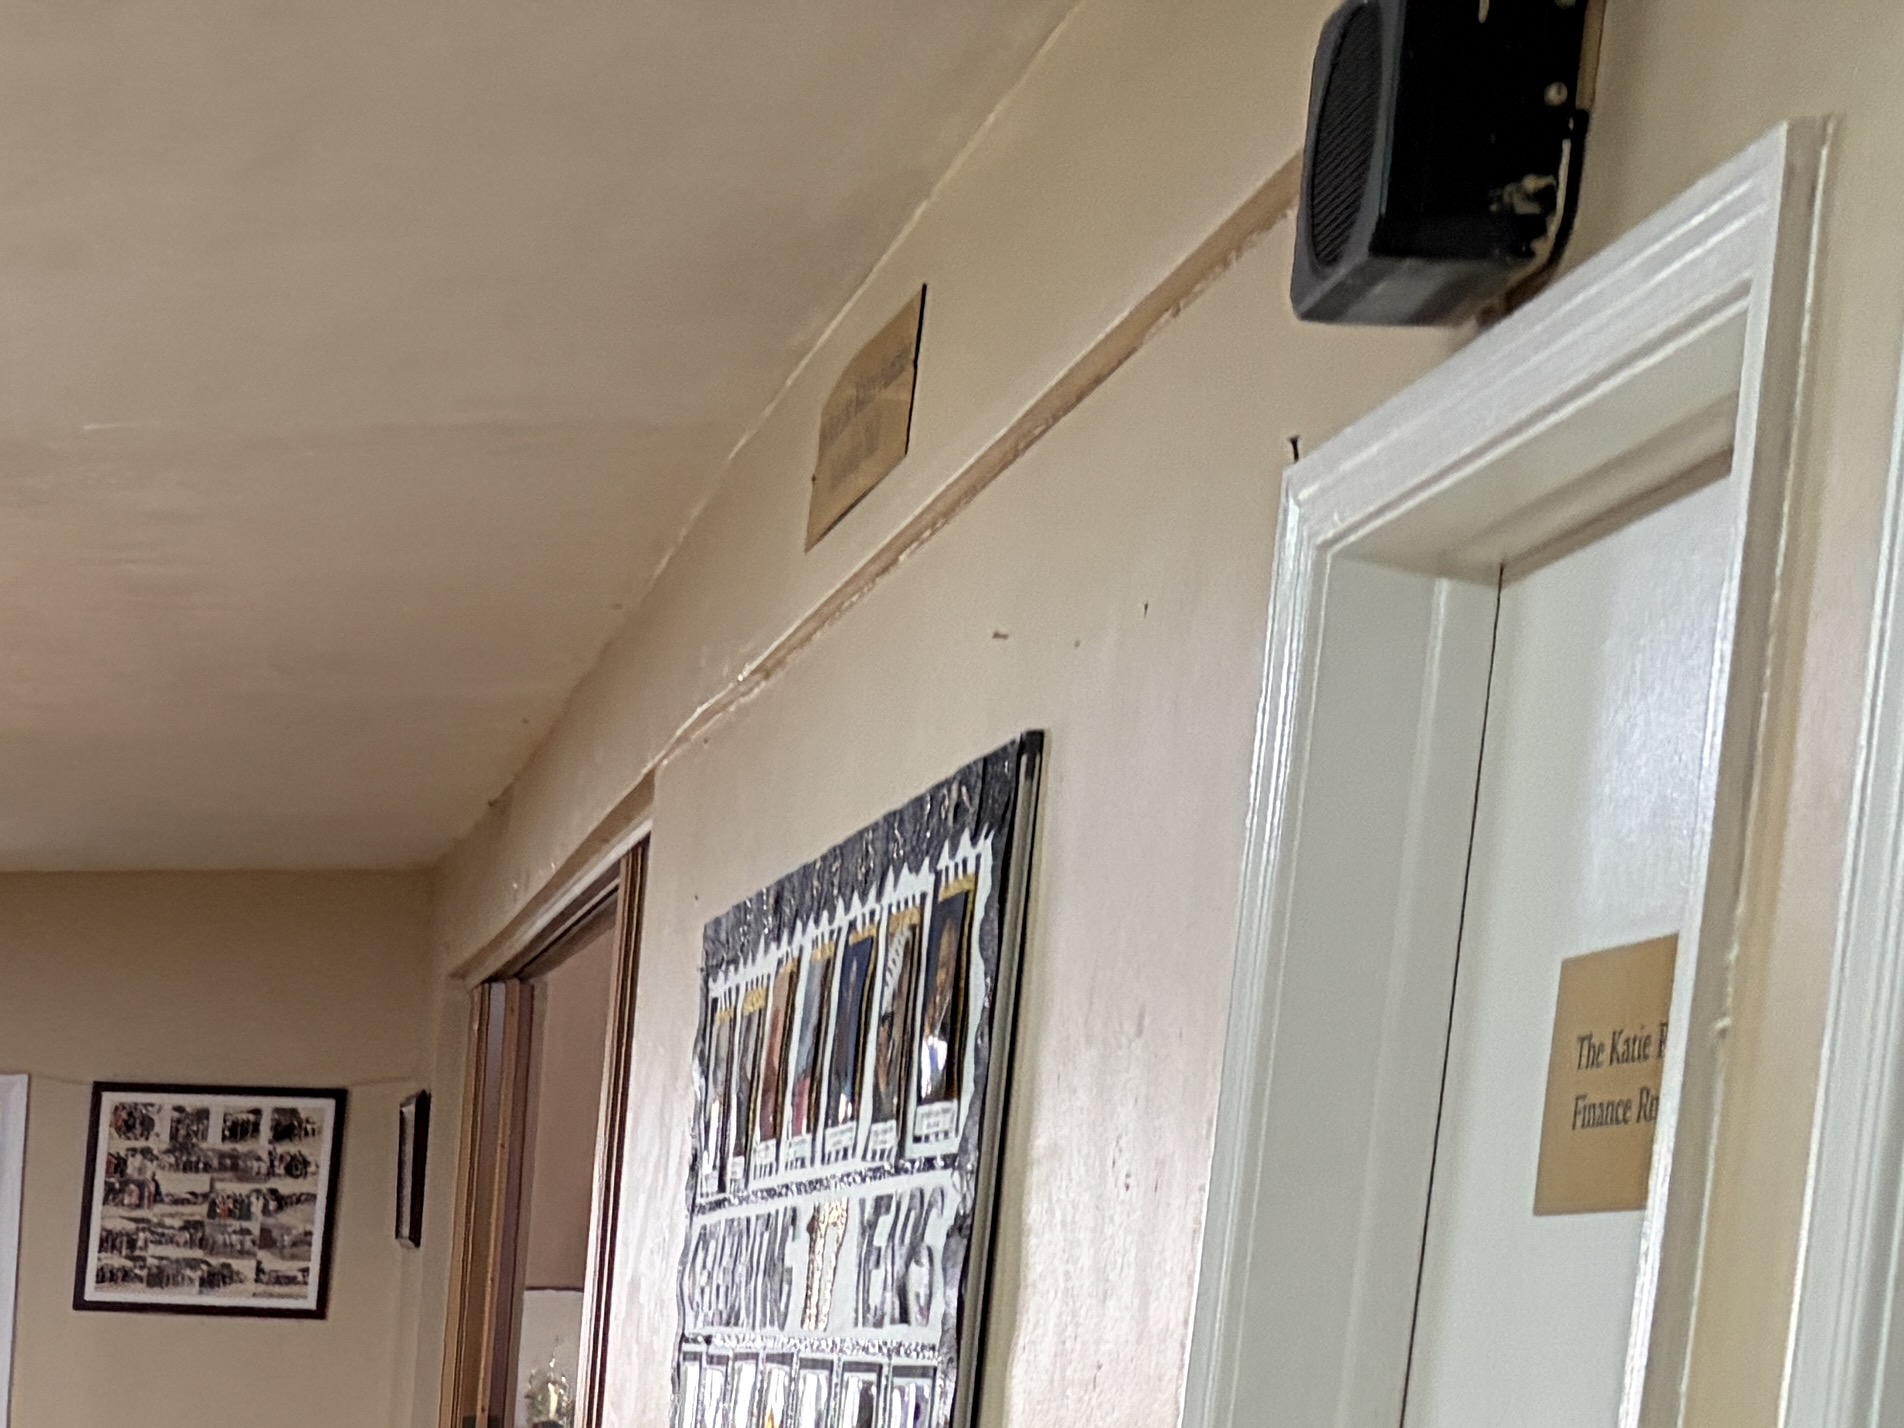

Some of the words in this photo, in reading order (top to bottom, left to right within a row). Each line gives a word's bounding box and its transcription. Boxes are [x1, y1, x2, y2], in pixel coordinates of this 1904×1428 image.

[1577, 1031, 1605, 1071] The
[1609, 1024, 1652, 1066] Katie
[1572, 1091, 1632, 1130] Finance
